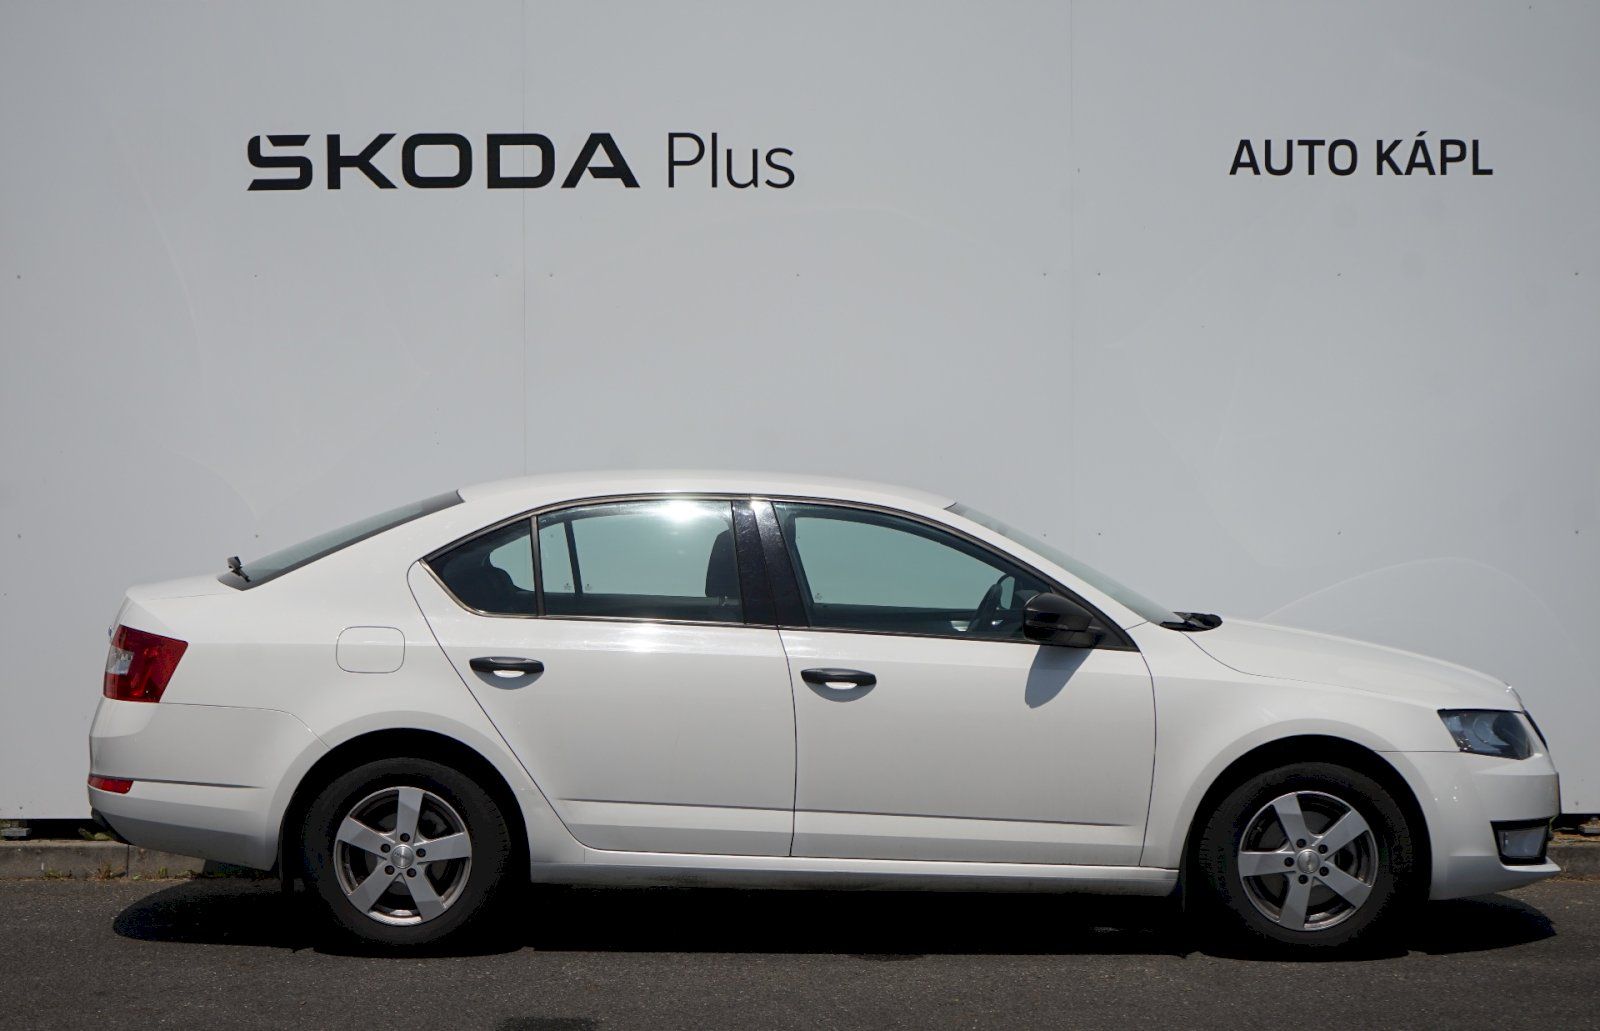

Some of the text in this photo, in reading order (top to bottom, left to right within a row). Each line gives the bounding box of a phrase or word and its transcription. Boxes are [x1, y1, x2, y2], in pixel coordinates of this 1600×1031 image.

[667, 132, 795, 189] Plus
[1229, 130, 1493, 176] AUTO KÁPL
